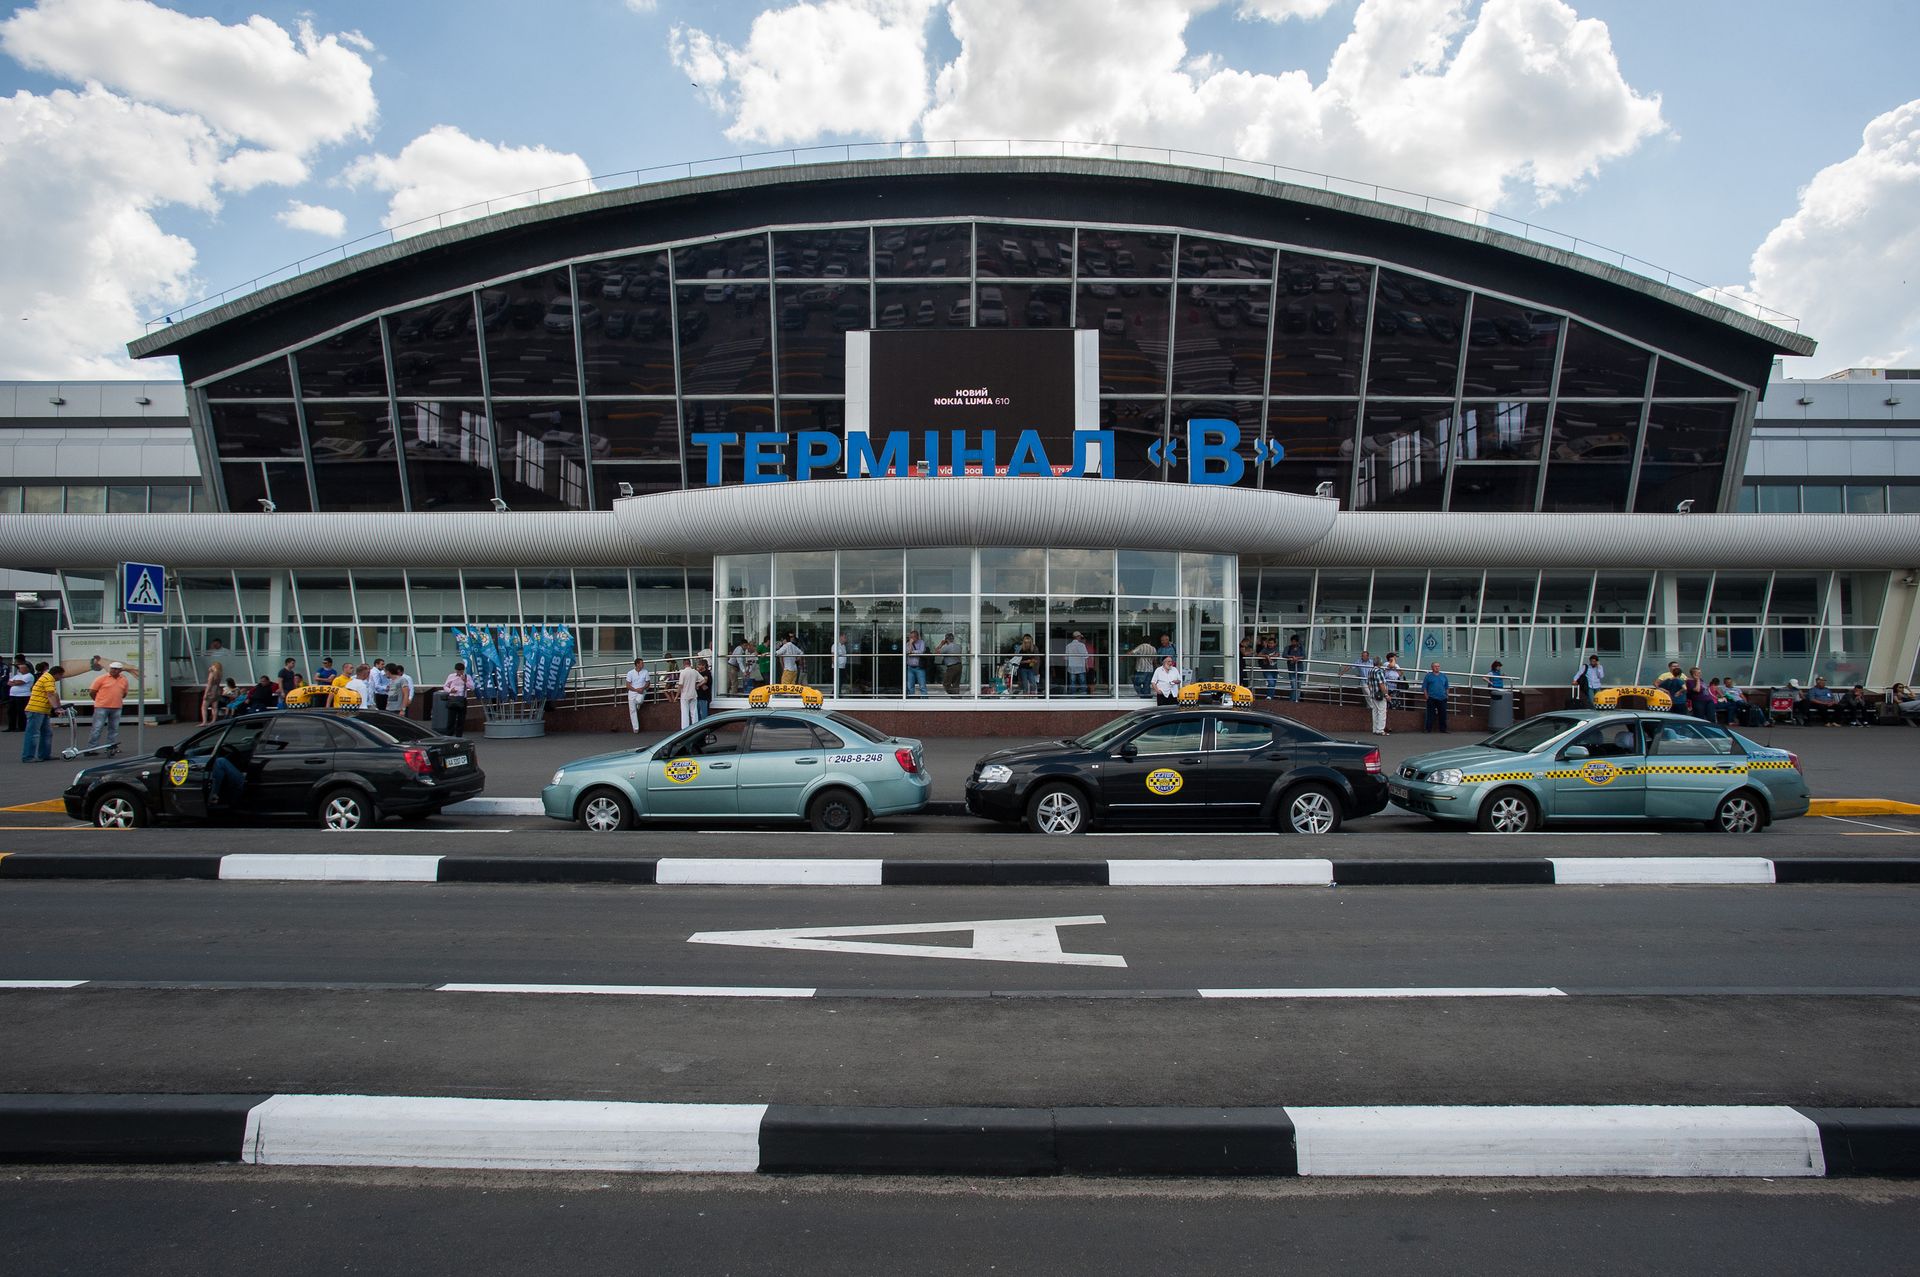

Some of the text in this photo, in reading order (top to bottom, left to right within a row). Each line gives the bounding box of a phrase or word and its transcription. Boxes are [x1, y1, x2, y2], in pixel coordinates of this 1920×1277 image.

[955, 387, 988, 397] НОВИЙ
[934, 397, 1010, 405] NOKIA LUMIA 610
[691, 429, 1115, 486] ТЕРМІНАЛ
[302, 686, 340, 695] 248-8-248
[766, 685, 804, 693] 248-8-248
[1198, 683, 1237, 692] 248-8-248
[1616, 687, 1655, 696] 248-8-248
[834, 753, 883, 763] 248-8-248
